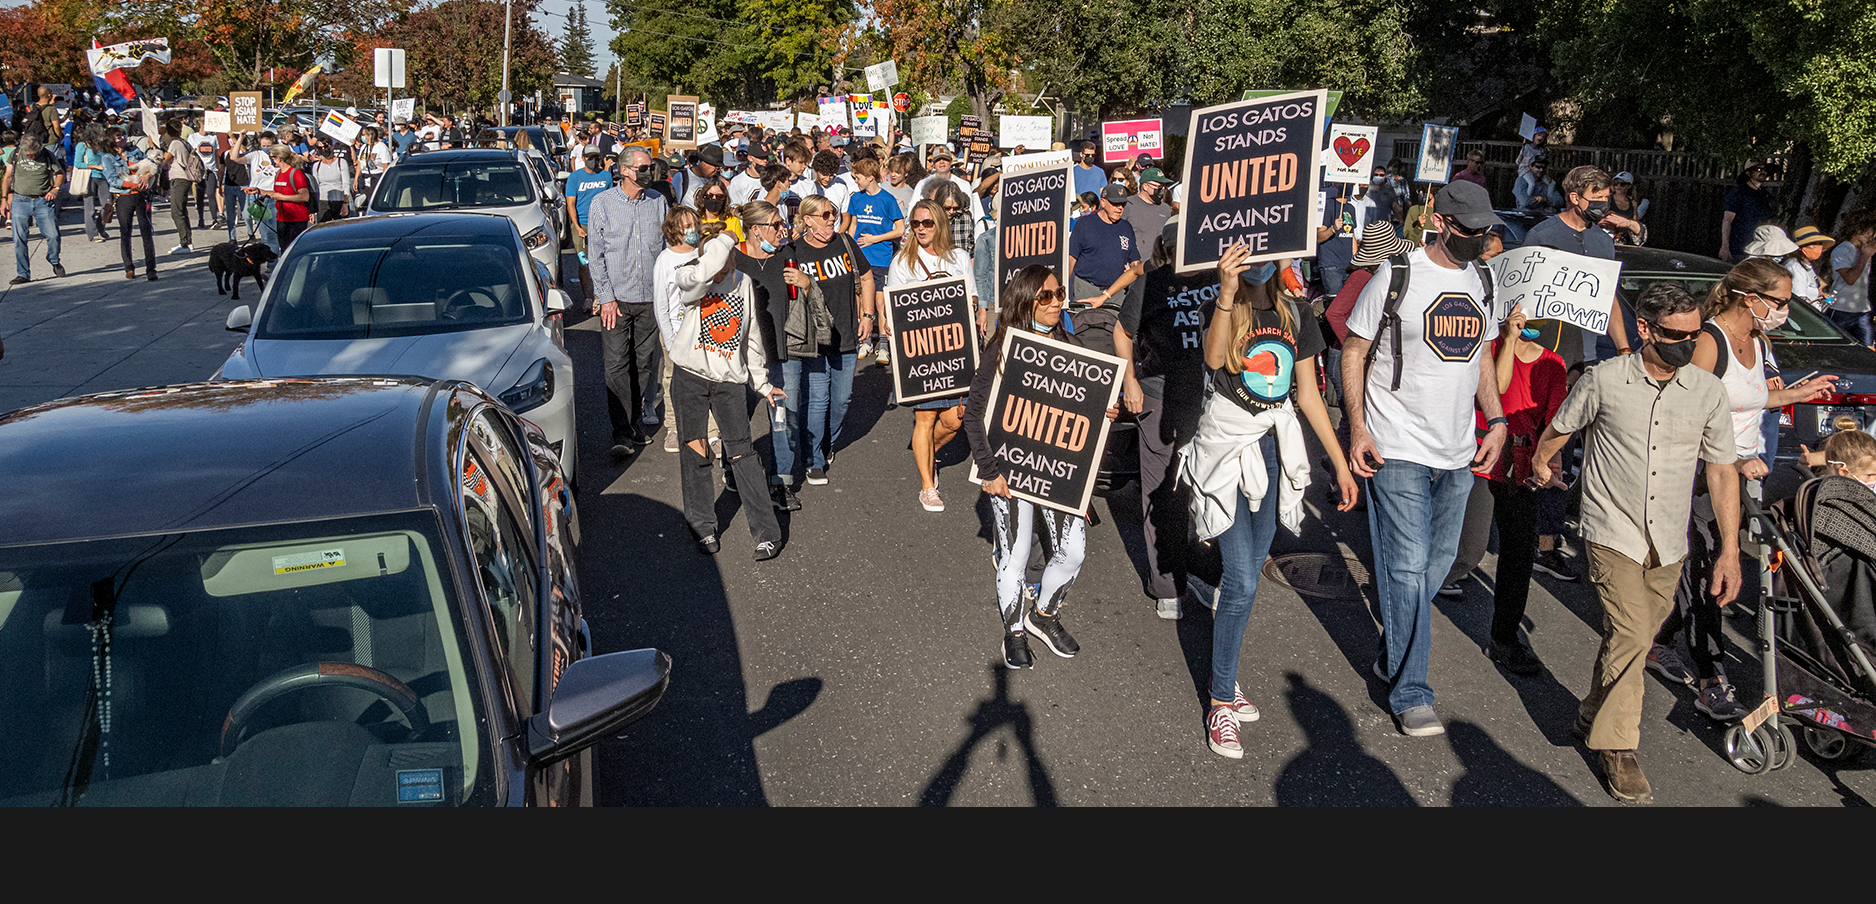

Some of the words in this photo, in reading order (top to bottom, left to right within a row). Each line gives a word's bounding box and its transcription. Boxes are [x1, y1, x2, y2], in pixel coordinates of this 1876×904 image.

[234, 96, 256, 107] STOP
[234, 106, 257, 116] ASIAN
[854, 101, 873, 110] LOVE
[893, 98, 910, 106] STOP
[236, 115, 257, 125] HATE
[672, 117, 692, 127] UNITED
[1201, 113, 1238, 134] LOS
[1242, 101, 1313, 126] GATOS
[970, 141, 990, 153] UNITED
[1106, 135, 1128, 143] Spread
[1214, 127, 1287, 152] STANDS
[1338, 146, 1363, 156] LOVE
[577, 180, 607, 192] LIONS
[1005, 180, 1024, 197] LOS
[1025, 173, 1065, 195] GATOS
[1200, 152, 1299, 204] UNITED
[1011, 196, 1050, 216] STANDS
[1198, 204, 1294, 234] AGAINST
[1004, 220, 1057, 260] UNITED
[1218, 231, 1269, 257] HATE
[799, 252, 852, 282] BELONG
[1552, 266, 1600, 298] in
[894, 292, 919, 308] LOS
[921, 284, 965, 303] GATOS
[1441, 302, 1453, 311] LOS
[1453, 301, 1472, 312] GATOS
[907, 303, 953, 322] STANDS
[1533, 284, 1609, 332] town
[1255, 327, 1282, 336] MARCH
[1433, 315, 1480, 338] UNITED
[902, 322, 965, 359] UNITED
[1438, 340, 1460, 354] AGAINST
[1461, 341, 1473, 353] HATE
[908, 357, 966, 379] AGAINST
[1013, 342, 1048, 367] LOS
[1050, 354, 1113, 385] GATOS
[923, 375, 955, 392] HATE
[1021, 371, 1087, 402] STANDS
[1236, 387, 1250, 401] OUR
[1001, 393, 1091, 453] UNITED
[994, 442, 1078, 481] AGAINST
[1007, 469, 1053, 498] HATE
[284, 563, 325, 573] WARNING
